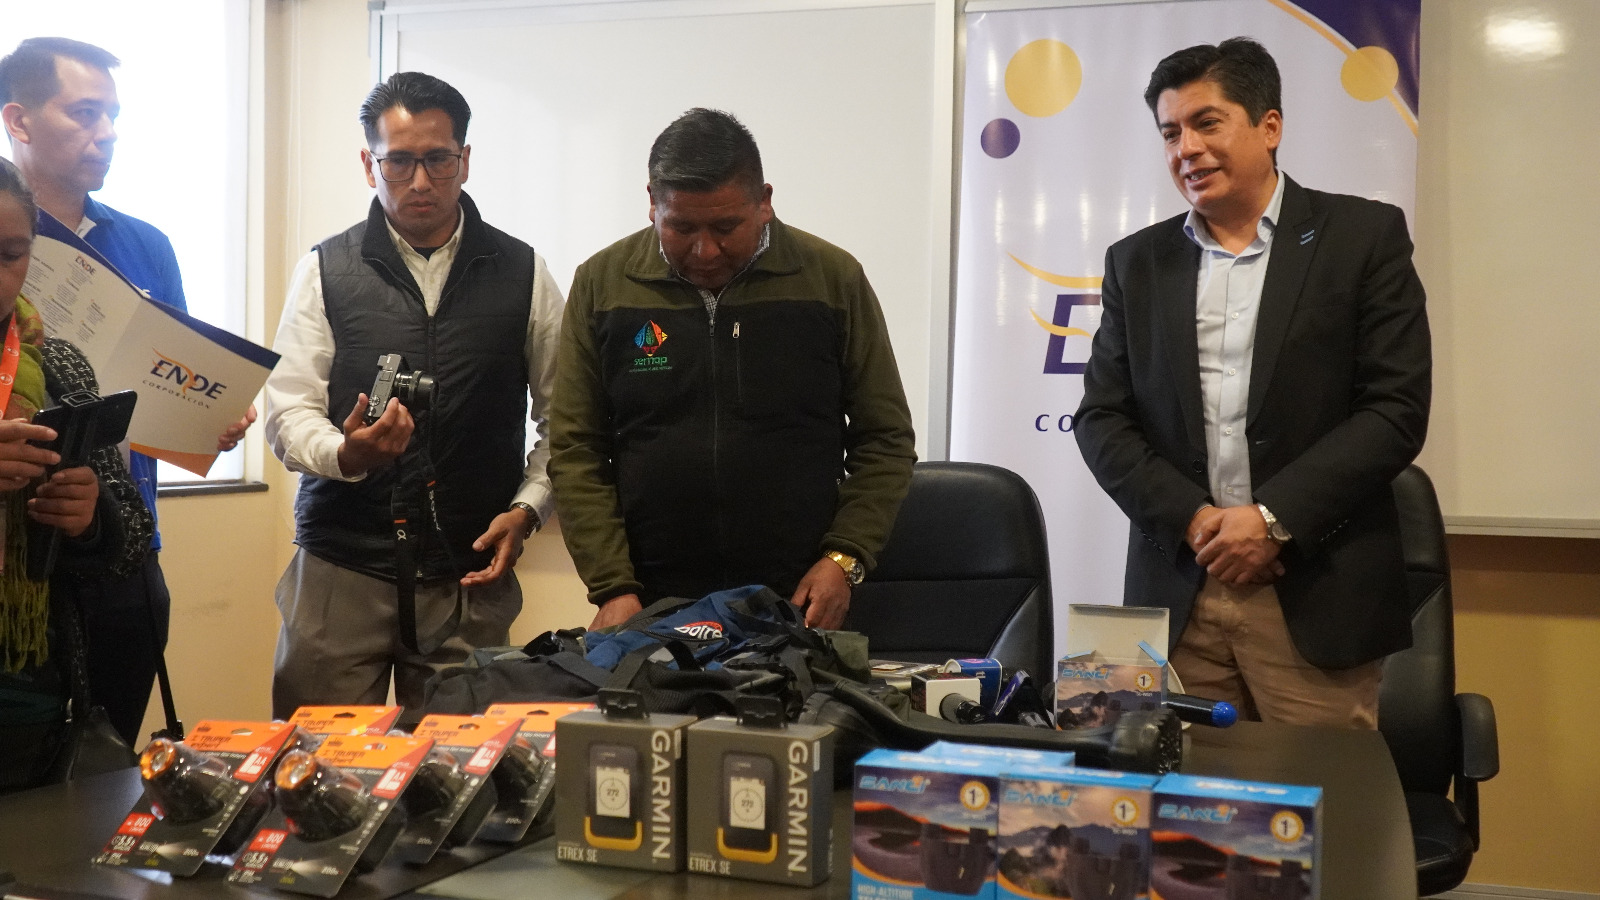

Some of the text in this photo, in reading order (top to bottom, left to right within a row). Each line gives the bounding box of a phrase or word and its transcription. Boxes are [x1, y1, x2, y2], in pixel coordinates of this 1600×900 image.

[150, 359, 228, 401] ENDE
[651, 729, 671, 861] GARMIN
[787, 740, 808, 874] GARMIN
[557, 845, 598, 863] ETREX SE
[688, 856, 731, 876] ETREX SE
